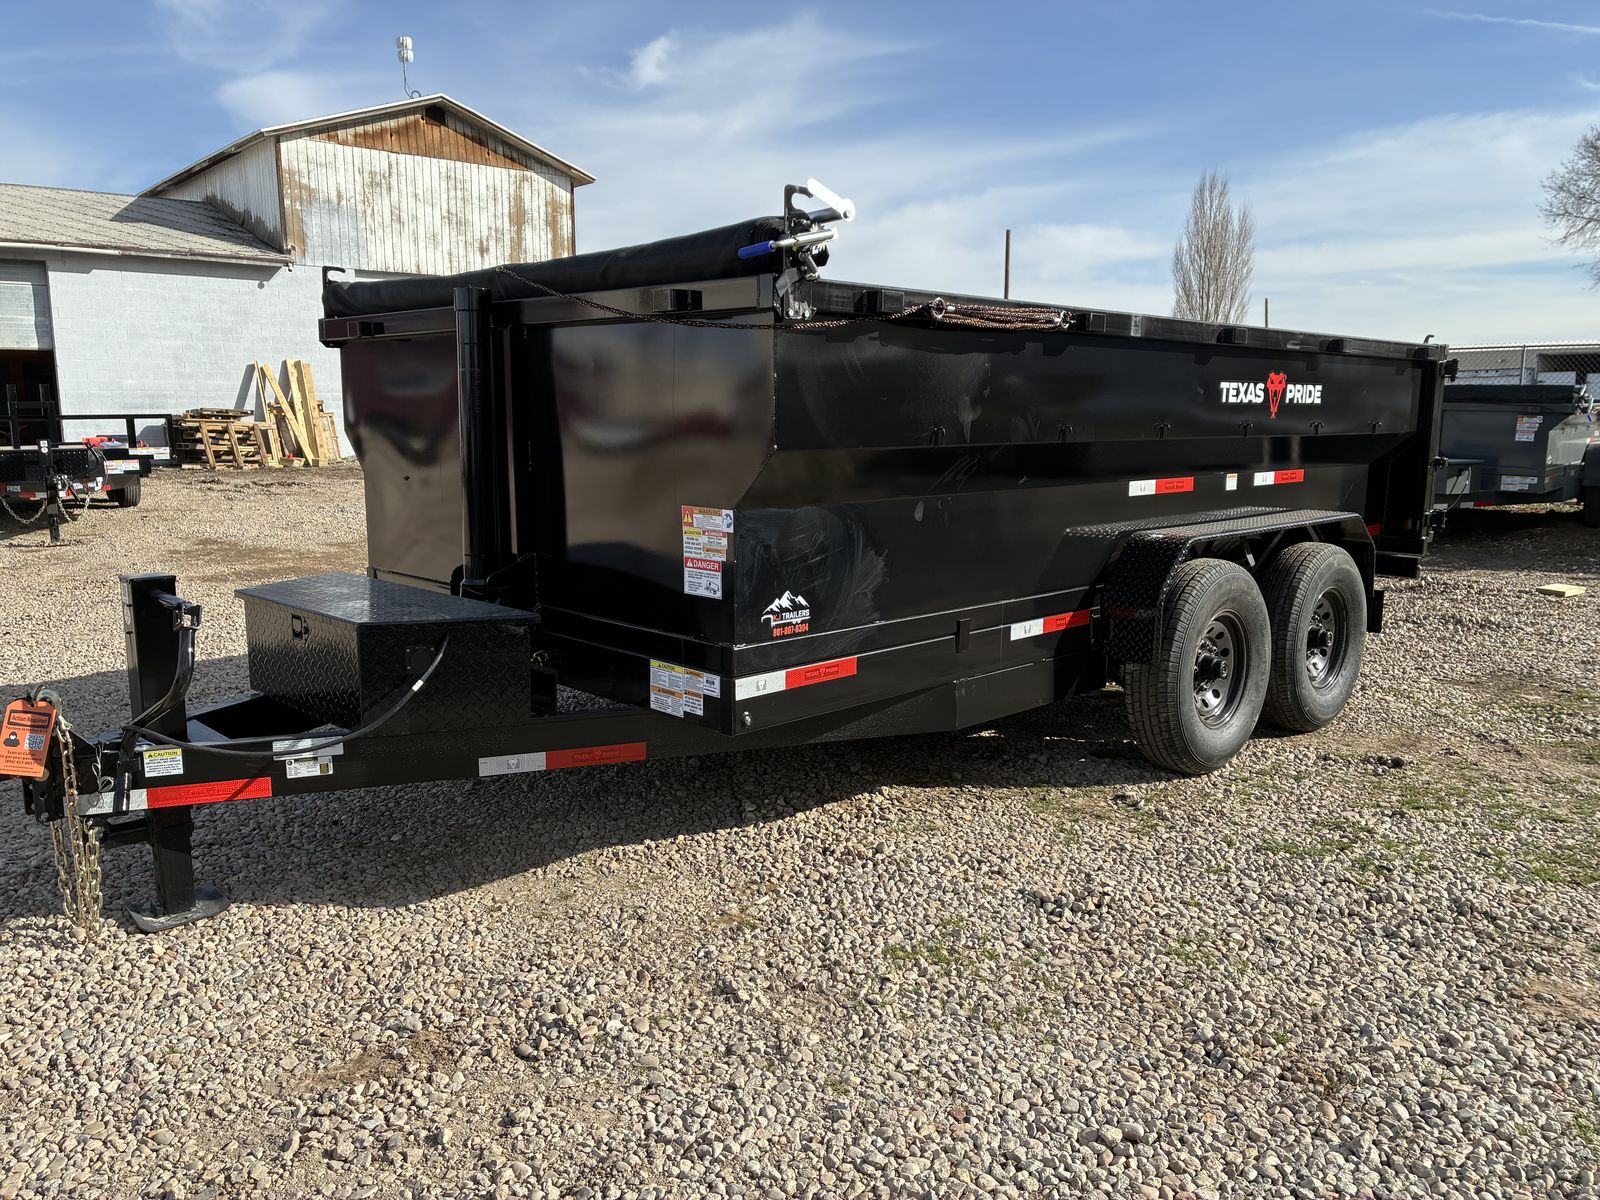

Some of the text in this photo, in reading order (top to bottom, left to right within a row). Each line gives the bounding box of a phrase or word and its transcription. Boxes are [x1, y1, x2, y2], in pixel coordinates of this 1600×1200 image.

[1220, 381, 1322, 404] TEXAS PRIDE
[693, 559, 719, 570] DANGER
[782, 609, 810, 620] TRAILERS
